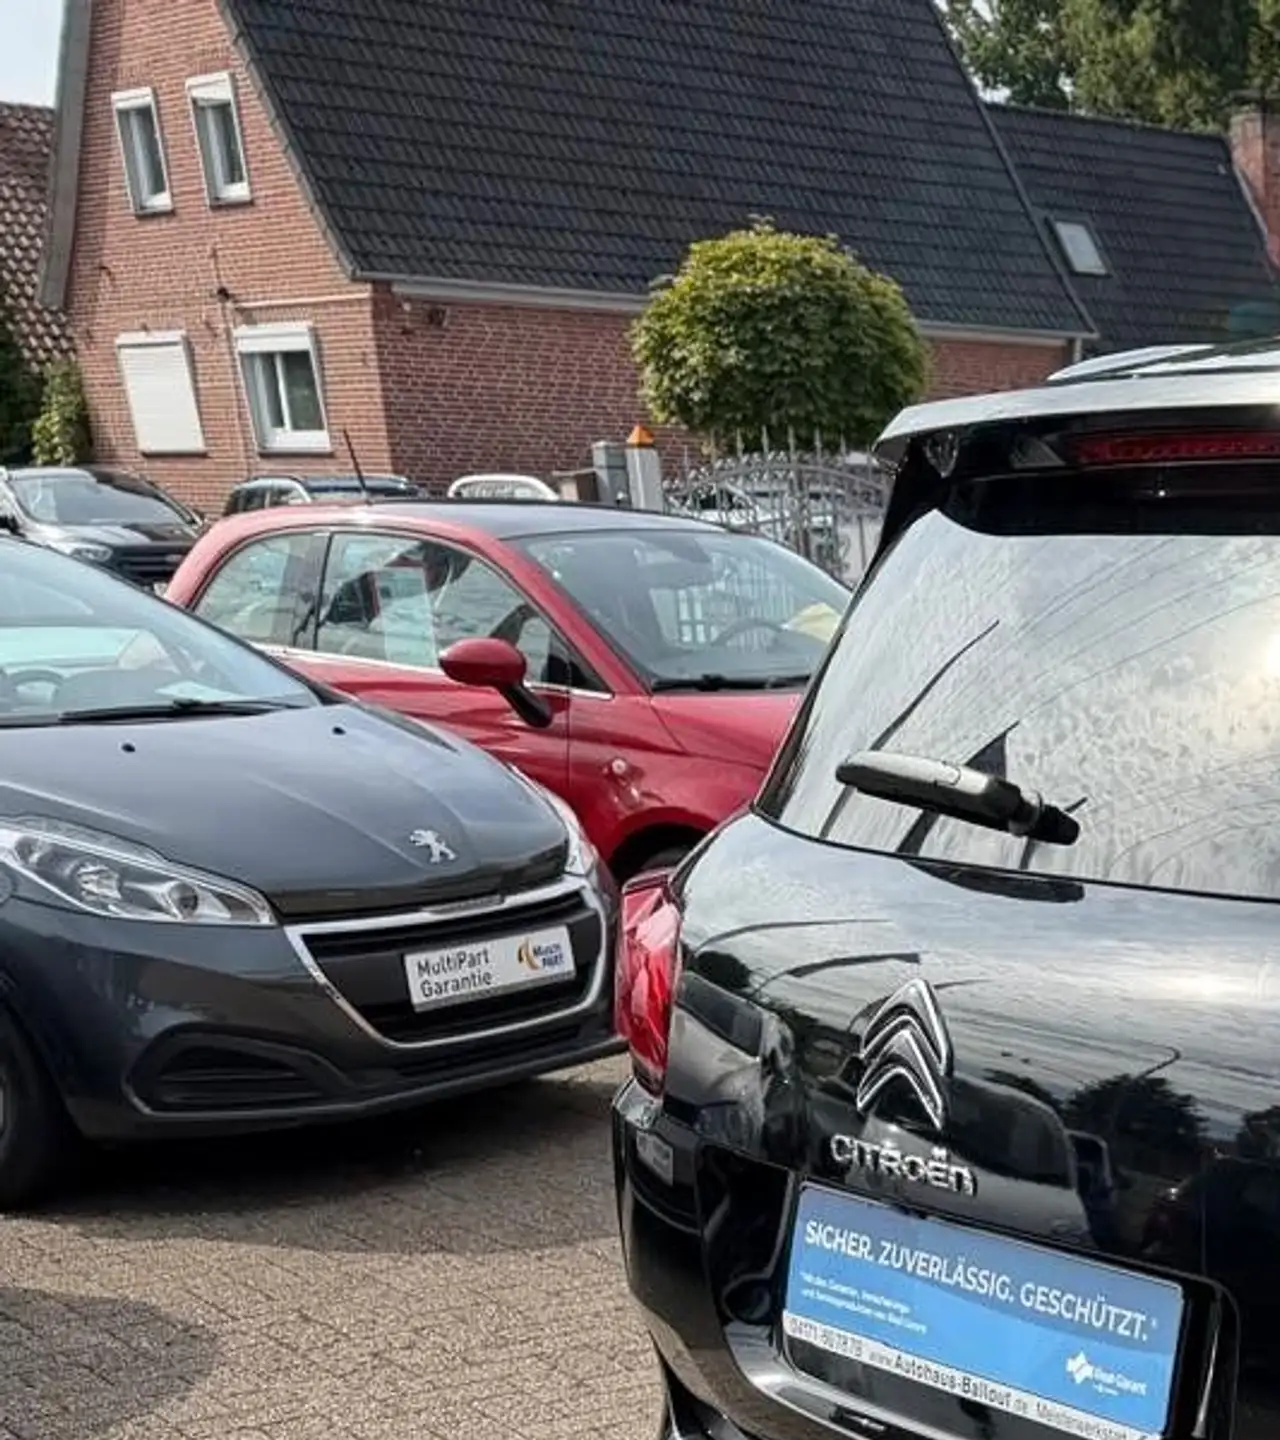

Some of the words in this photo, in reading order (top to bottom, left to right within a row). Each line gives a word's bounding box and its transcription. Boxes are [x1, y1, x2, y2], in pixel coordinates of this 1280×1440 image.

[417, 949, 490, 977] MultiPart
[420, 970, 493, 998] Garantie
[804, 1219, 873, 1262] SICHER.
[879, 1240, 1014, 1304] ZUVERLÄSSIG.
